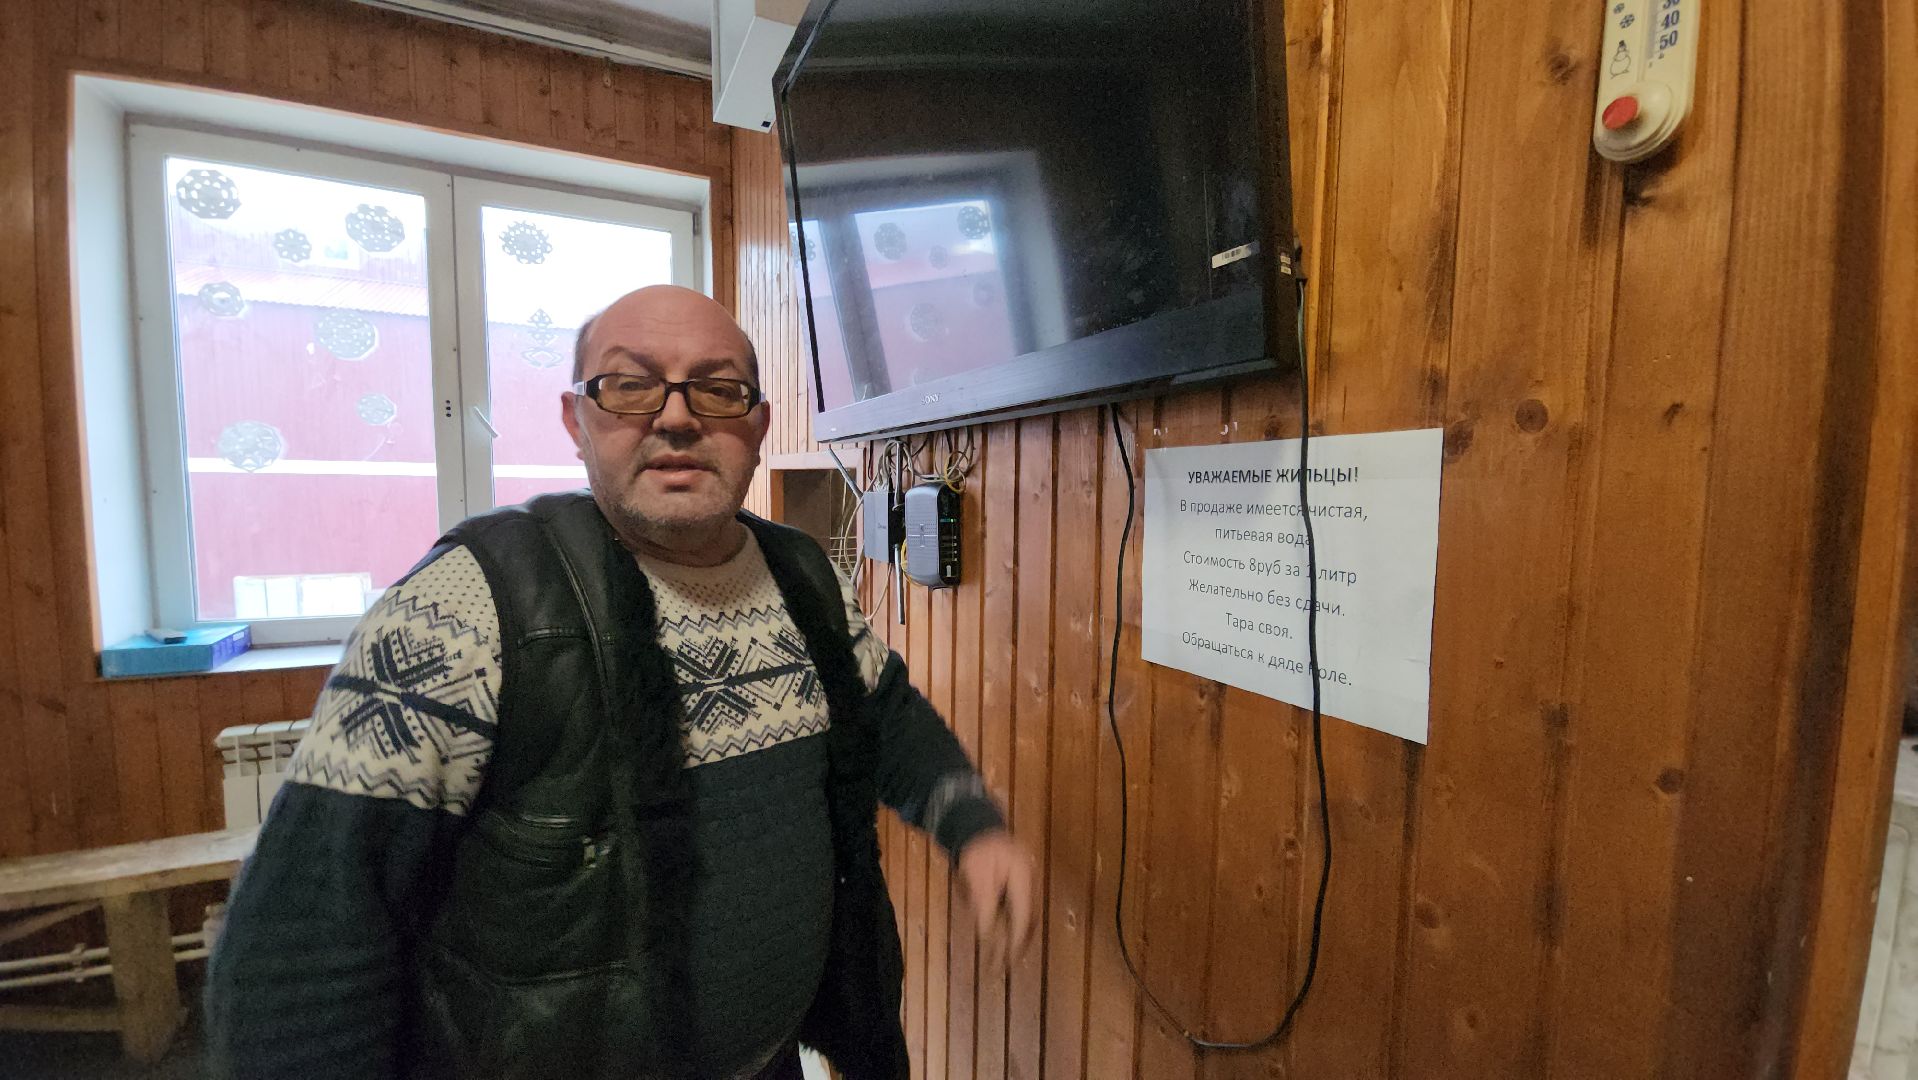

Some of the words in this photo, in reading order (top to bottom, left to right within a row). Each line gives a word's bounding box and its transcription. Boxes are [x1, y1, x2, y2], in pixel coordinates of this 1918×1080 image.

[1661, 10, 1680, 30] 40
[1659, 30, 1678, 50] 50
[1188, 469, 1272, 484] УВАЖАЕМЫЕ
[1180, 499, 1187, 512] В
[1190, 502, 1243, 516] продаже
[1247, 504, 1305, 517] имеется
[1308, 505, 1368, 522] чистая,
[1215, 528, 1273, 543] питьевая
[1183, 550, 1246, 570] Стоимость
[1249, 557, 1281, 577] 8руб
[1285, 564, 1300, 577] за
[1318, 568, 1357, 587] литр
[1188, 578, 1264, 603] Желательно
[1267, 589, 1291, 608] без
[1295, 596, 1345, 617] сдачи.
[1225, 612, 1254, 632] Тара
[1258, 621, 1293, 640] своя.
[1182, 631, 1253, 661] Обращаться
[1258, 652, 1265, 664] к
[1268, 655, 1304, 676] дяде
